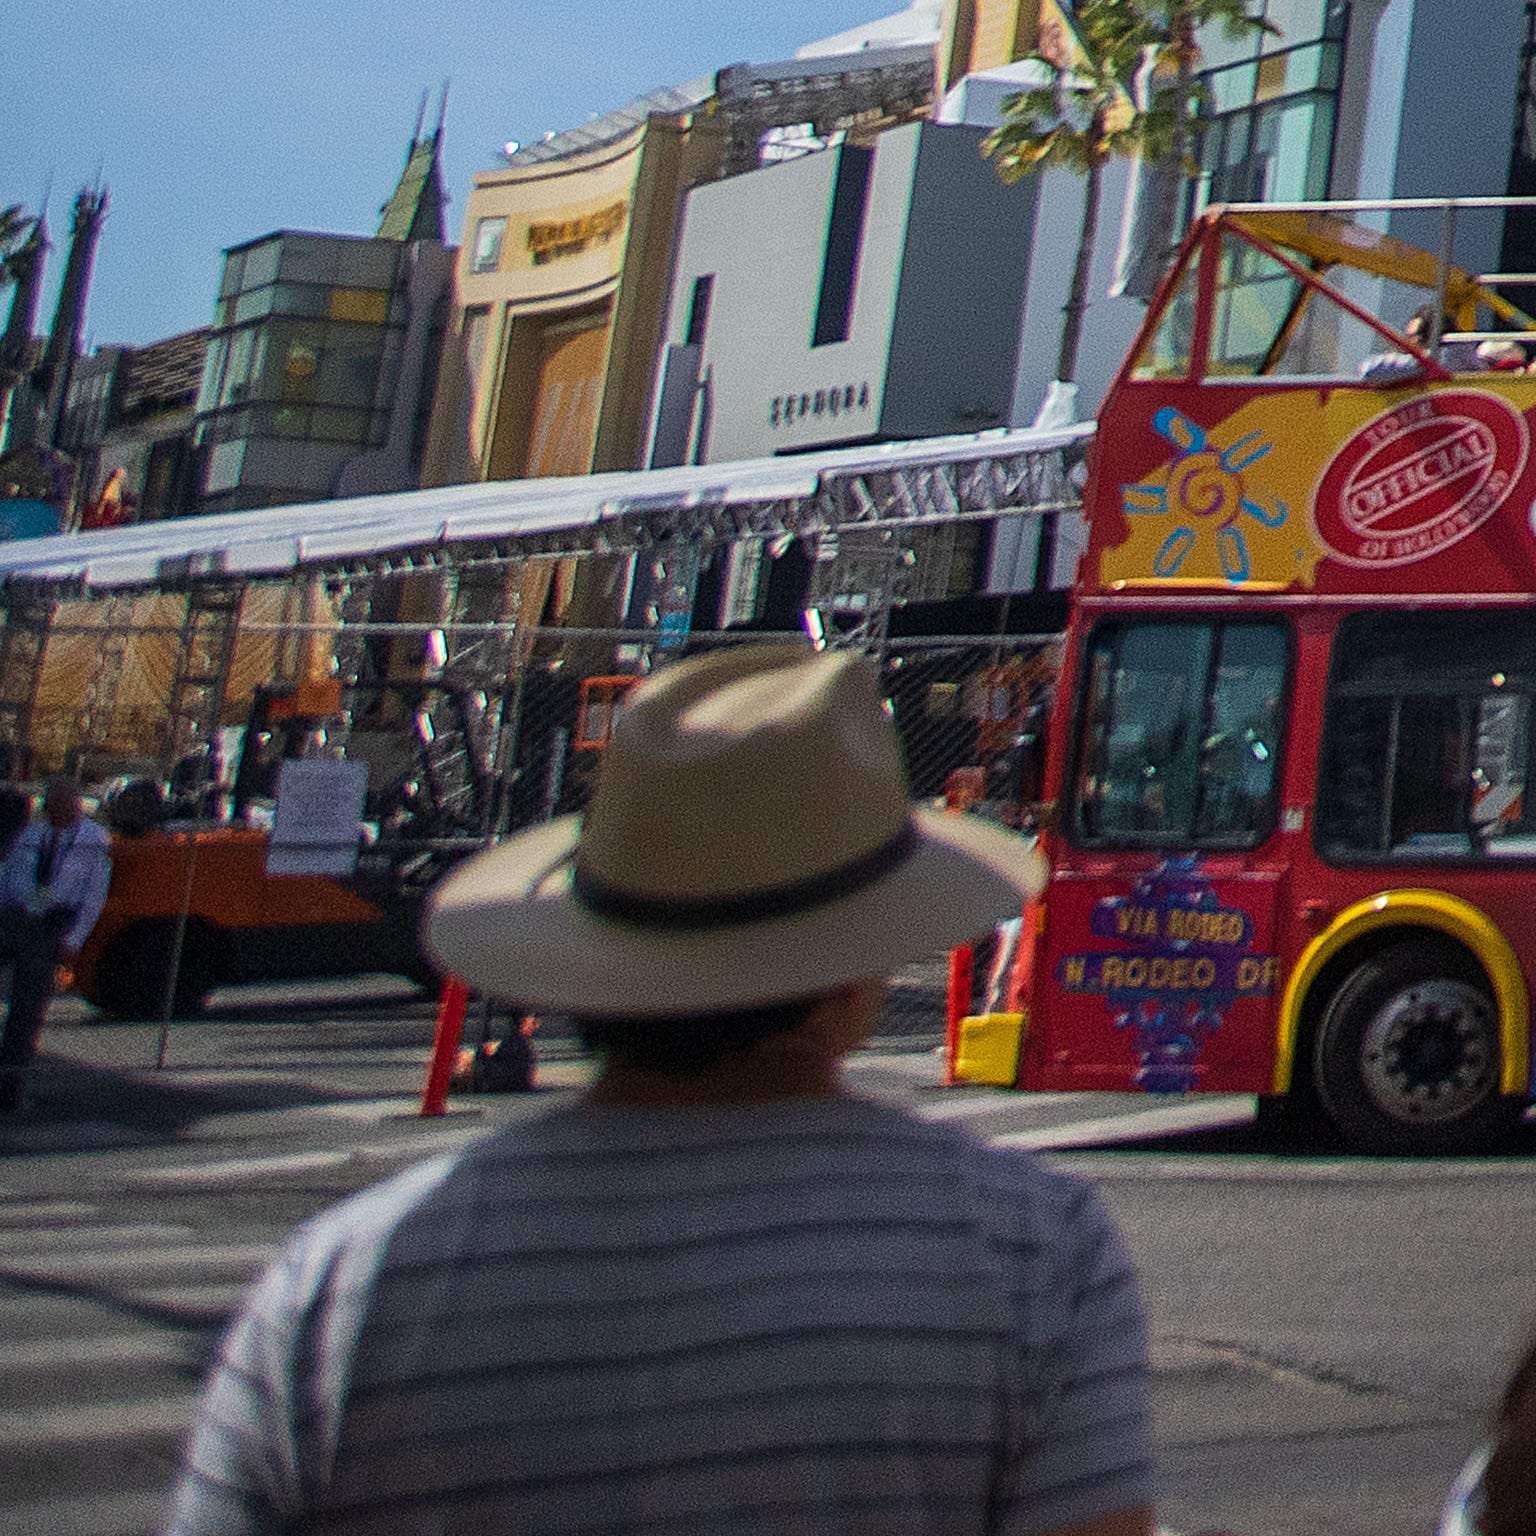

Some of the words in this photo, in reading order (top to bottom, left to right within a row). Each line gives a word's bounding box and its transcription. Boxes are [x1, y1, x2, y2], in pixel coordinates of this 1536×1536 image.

[768, 378, 871, 429] SEPHORA
[1116, 908, 1158, 937] VIA
[1101, 956, 1217, 990] RODEO
